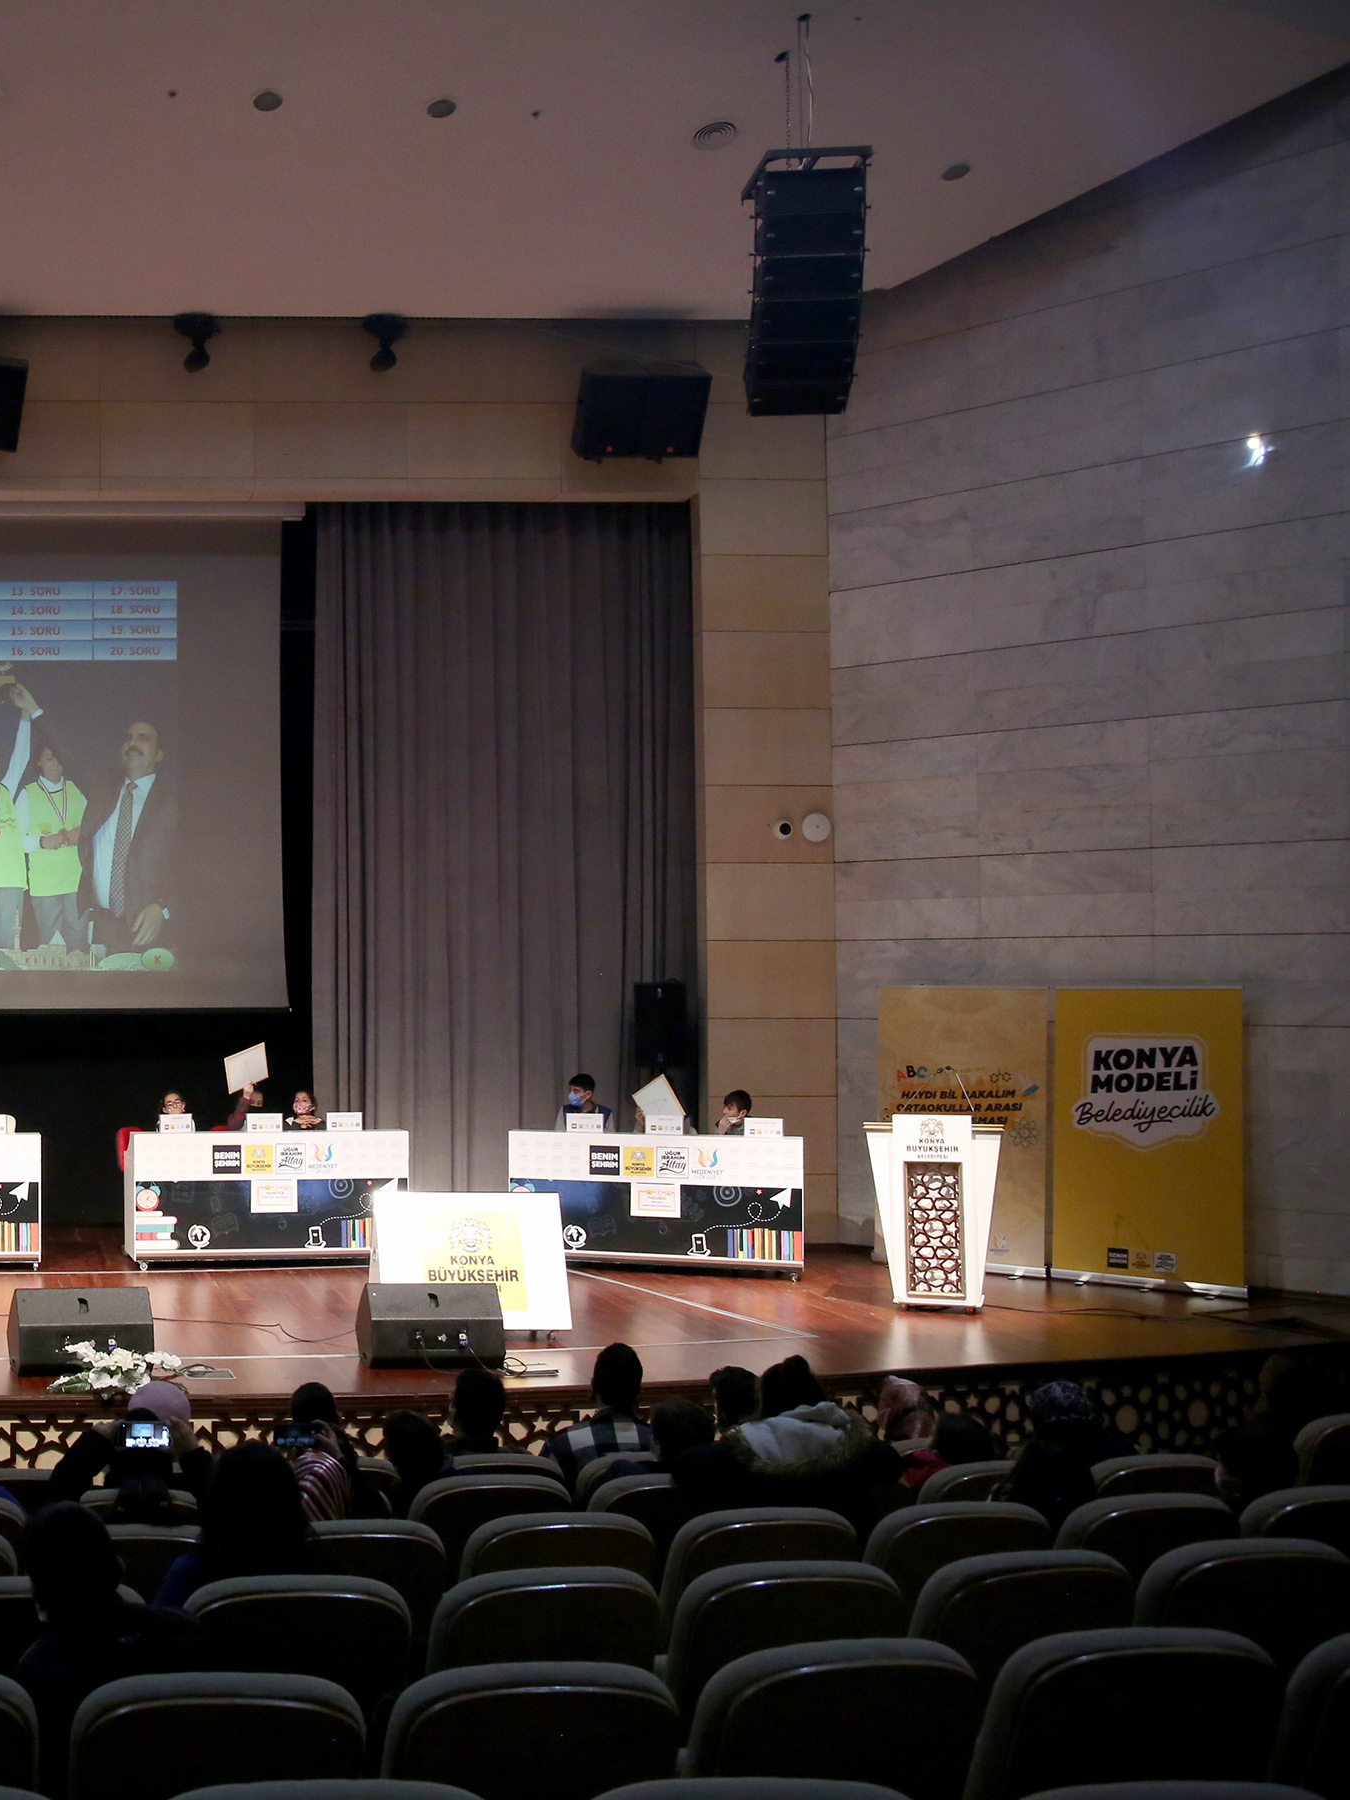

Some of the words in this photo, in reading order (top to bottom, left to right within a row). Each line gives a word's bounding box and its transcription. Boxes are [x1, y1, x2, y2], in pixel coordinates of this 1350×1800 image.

[11, 587, 27, 596] 13.
[30, 587, 60, 596] SORU
[110, 587, 126, 596] 17.
[130, 587, 160, 596] SORU
[11, 606, 27, 615] 14.
[30, 606, 60, 615] SORU
[110, 605, 126, 614] 18.
[130, 605, 160, 614] SORU
[11, 627, 27, 636] 15.
[30, 627, 60, 636] SORU
[110, 626, 126, 634] 19.
[130, 626, 160, 634] SORU
[11, 647, 27, 656] 16.
[30, 647, 60, 656] SORU
[110, 647, 126, 656] 20.
[130, 647, 160, 656] SORU
[1093, 1046, 1198, 1071] KONYA
[896, 1065, 927, 1082] ABC
[940, 1088, 957, 1099] BİL
[961, 1090, 1016, 1099] BAKALIM
[896, 1104, 982, 1112] ORTAOKULLAR
[985, 1102, 1023, 1112] ARASI
[1075, 1094, 1215, 1133] Belediyecilik
[278, 1155, 303, 1169] Altay
[659, 1159, 686, 1174] Altay
[450, 1255, 495, 1266] KONYA
[428, 1266, 519, 1284] BÜYÜKŞEHİR
